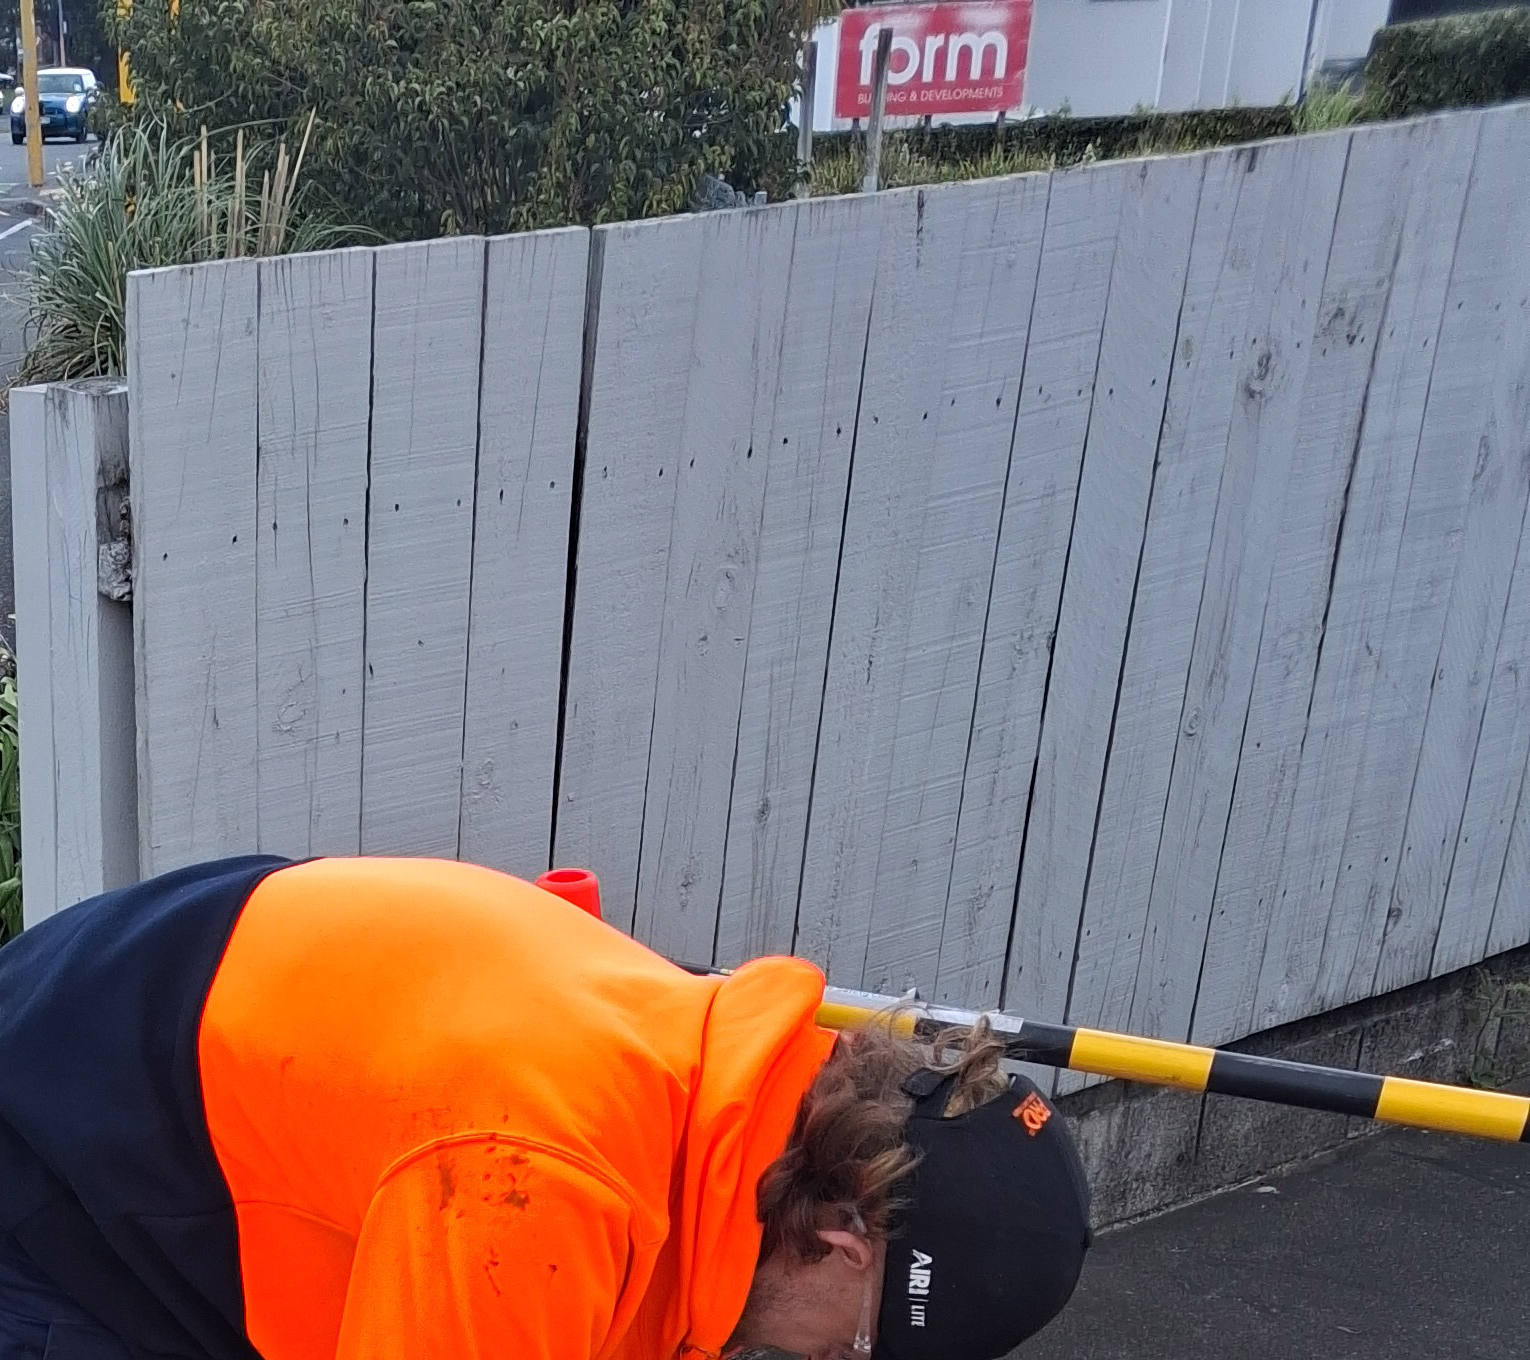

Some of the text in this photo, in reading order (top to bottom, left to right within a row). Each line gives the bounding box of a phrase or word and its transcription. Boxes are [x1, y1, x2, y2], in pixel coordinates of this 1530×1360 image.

[858, 22, 1008, 86] form
[857, 86, 1003, 105] BUING & DEVELOPMENTS
